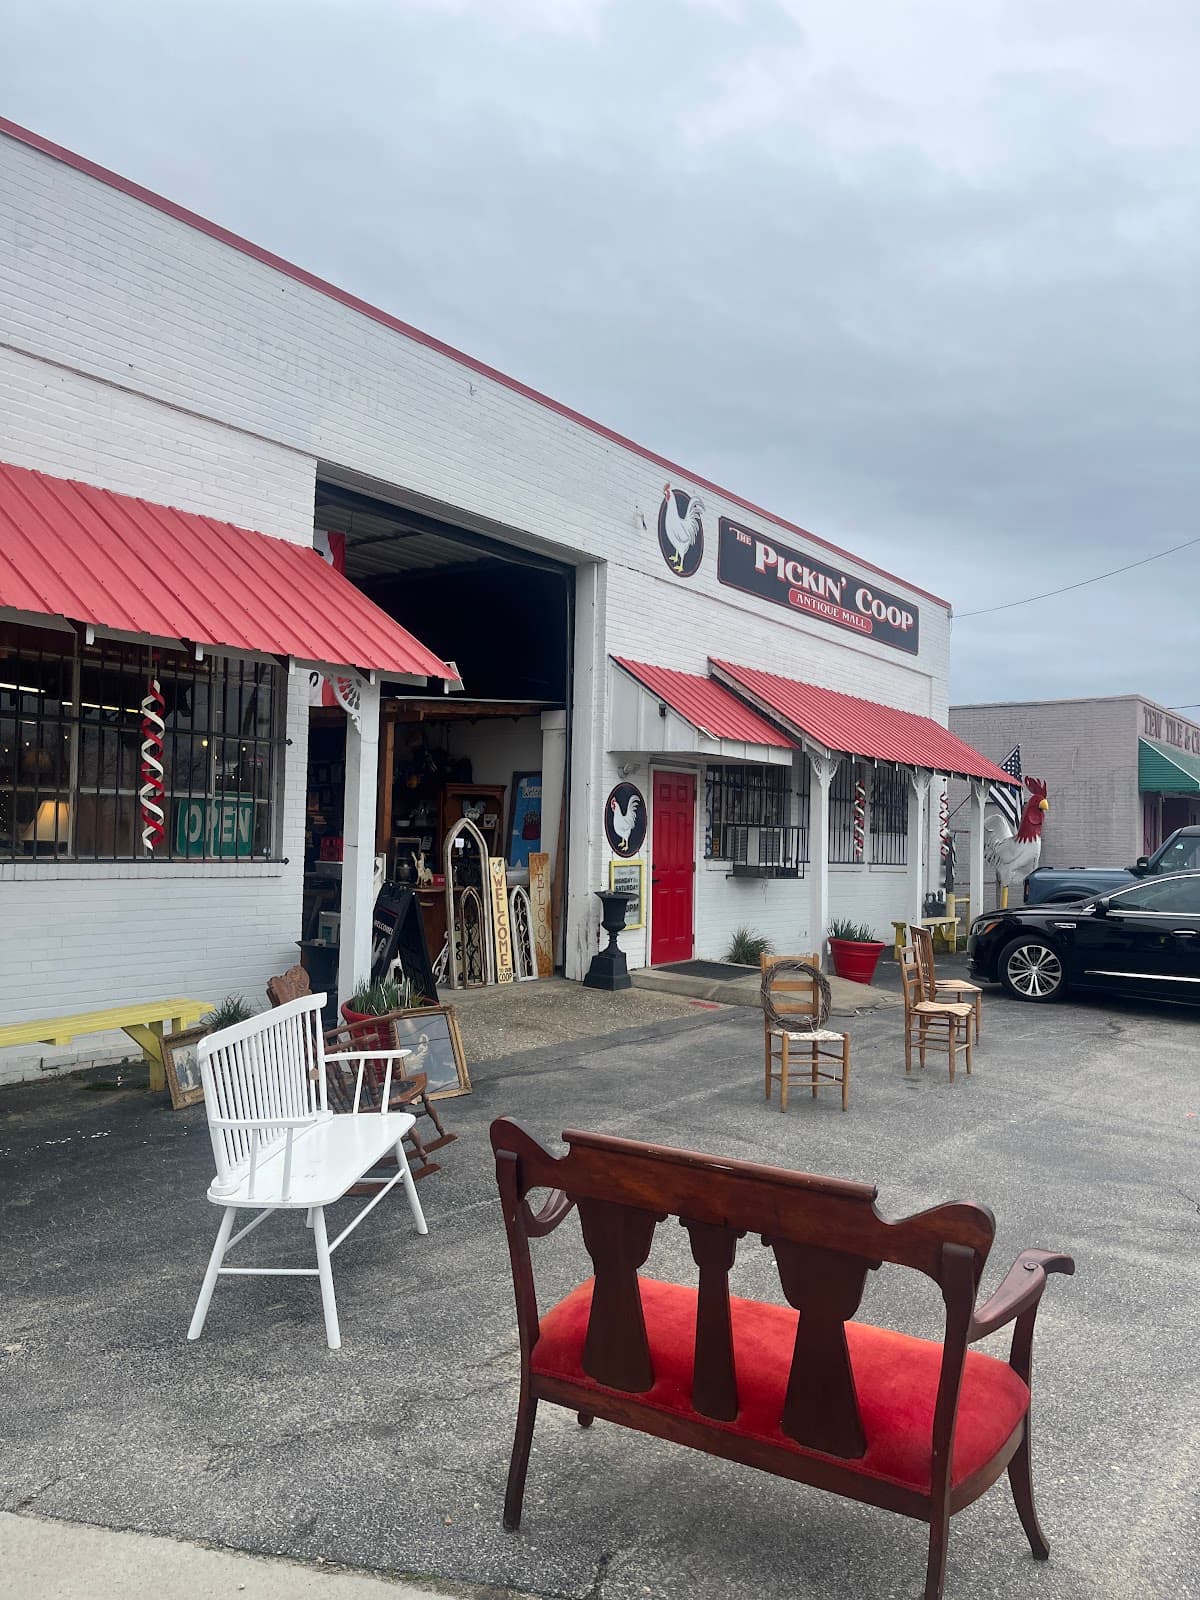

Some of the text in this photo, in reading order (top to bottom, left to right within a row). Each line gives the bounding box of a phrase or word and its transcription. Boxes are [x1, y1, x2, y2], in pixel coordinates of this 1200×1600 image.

[728, 527, 914, 631] THE PICKIN' COOP
[796, 593, 867, 630] ANTIQUE MALL
[184, 804, 252, 843] OPEN
[493, 875, 509, 967] WELCOME
[499, 973, 512, 981] COOP
